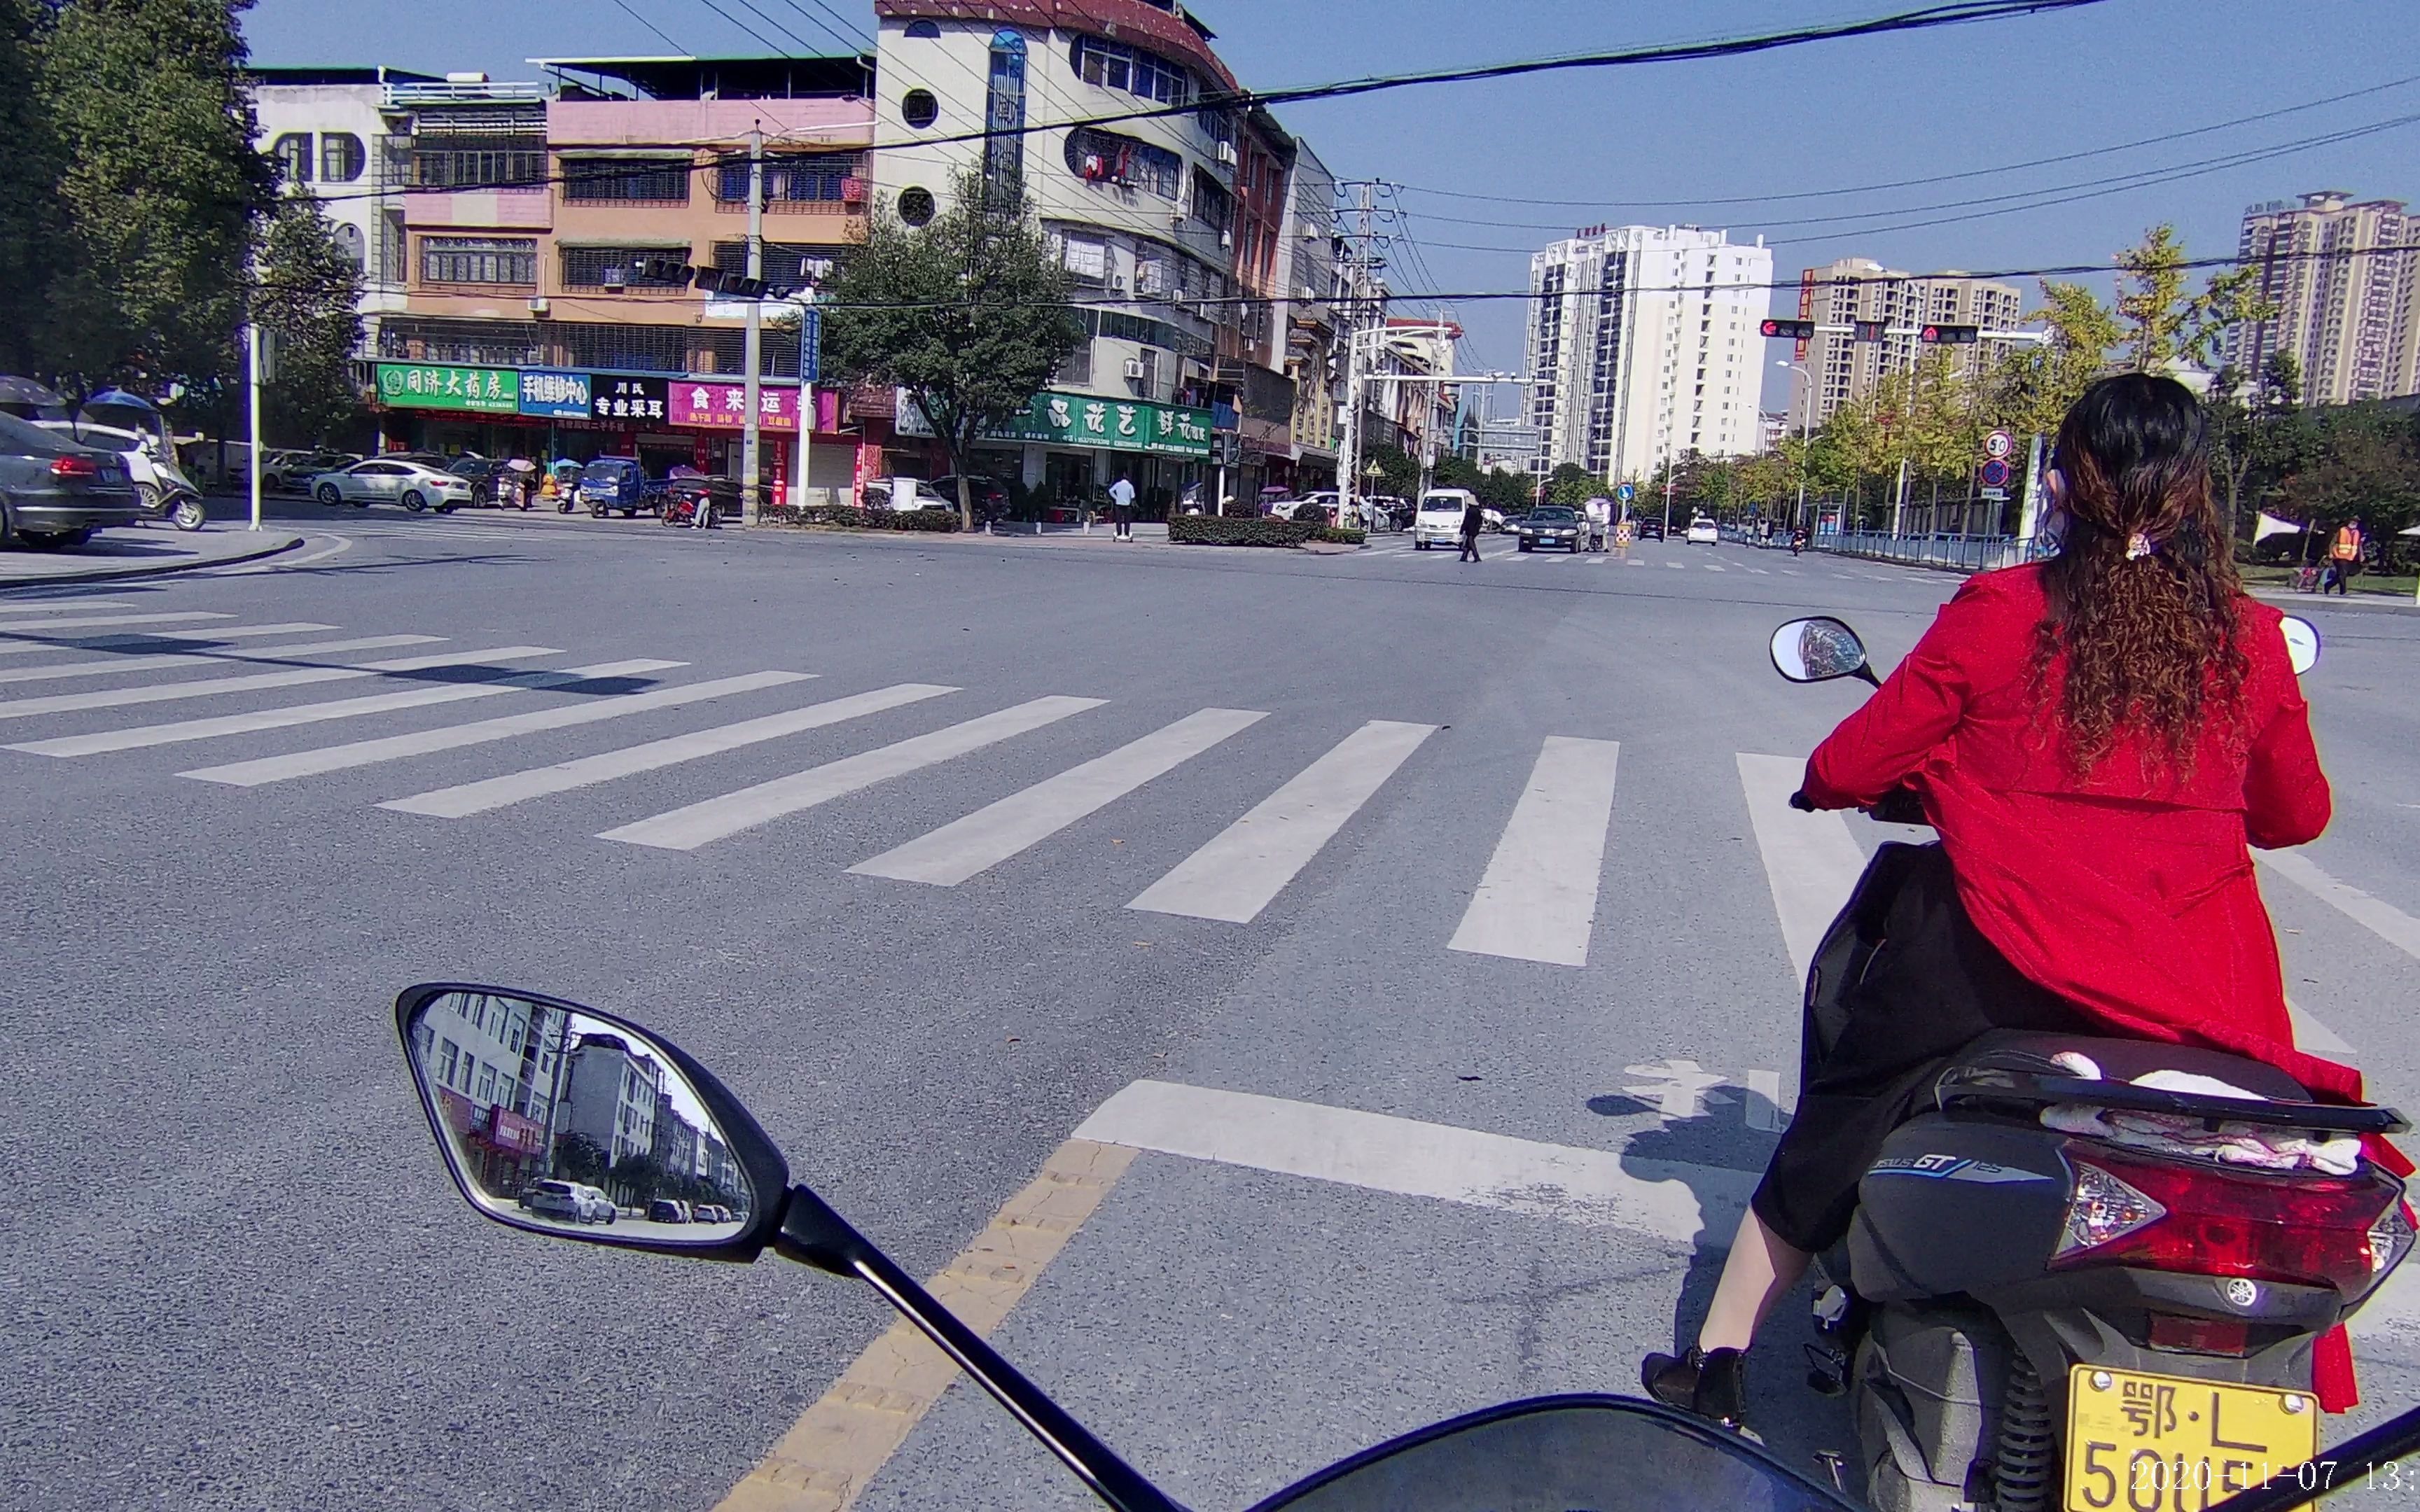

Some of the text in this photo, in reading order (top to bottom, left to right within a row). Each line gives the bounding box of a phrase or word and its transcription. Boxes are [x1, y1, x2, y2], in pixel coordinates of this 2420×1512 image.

[408, 370, 502, 400] 同济大药房
[616, 382, 644, 395] 川氏
[595, 396, 663, 419] 专业采耳
[1989, 439, 2006, 452] 50
